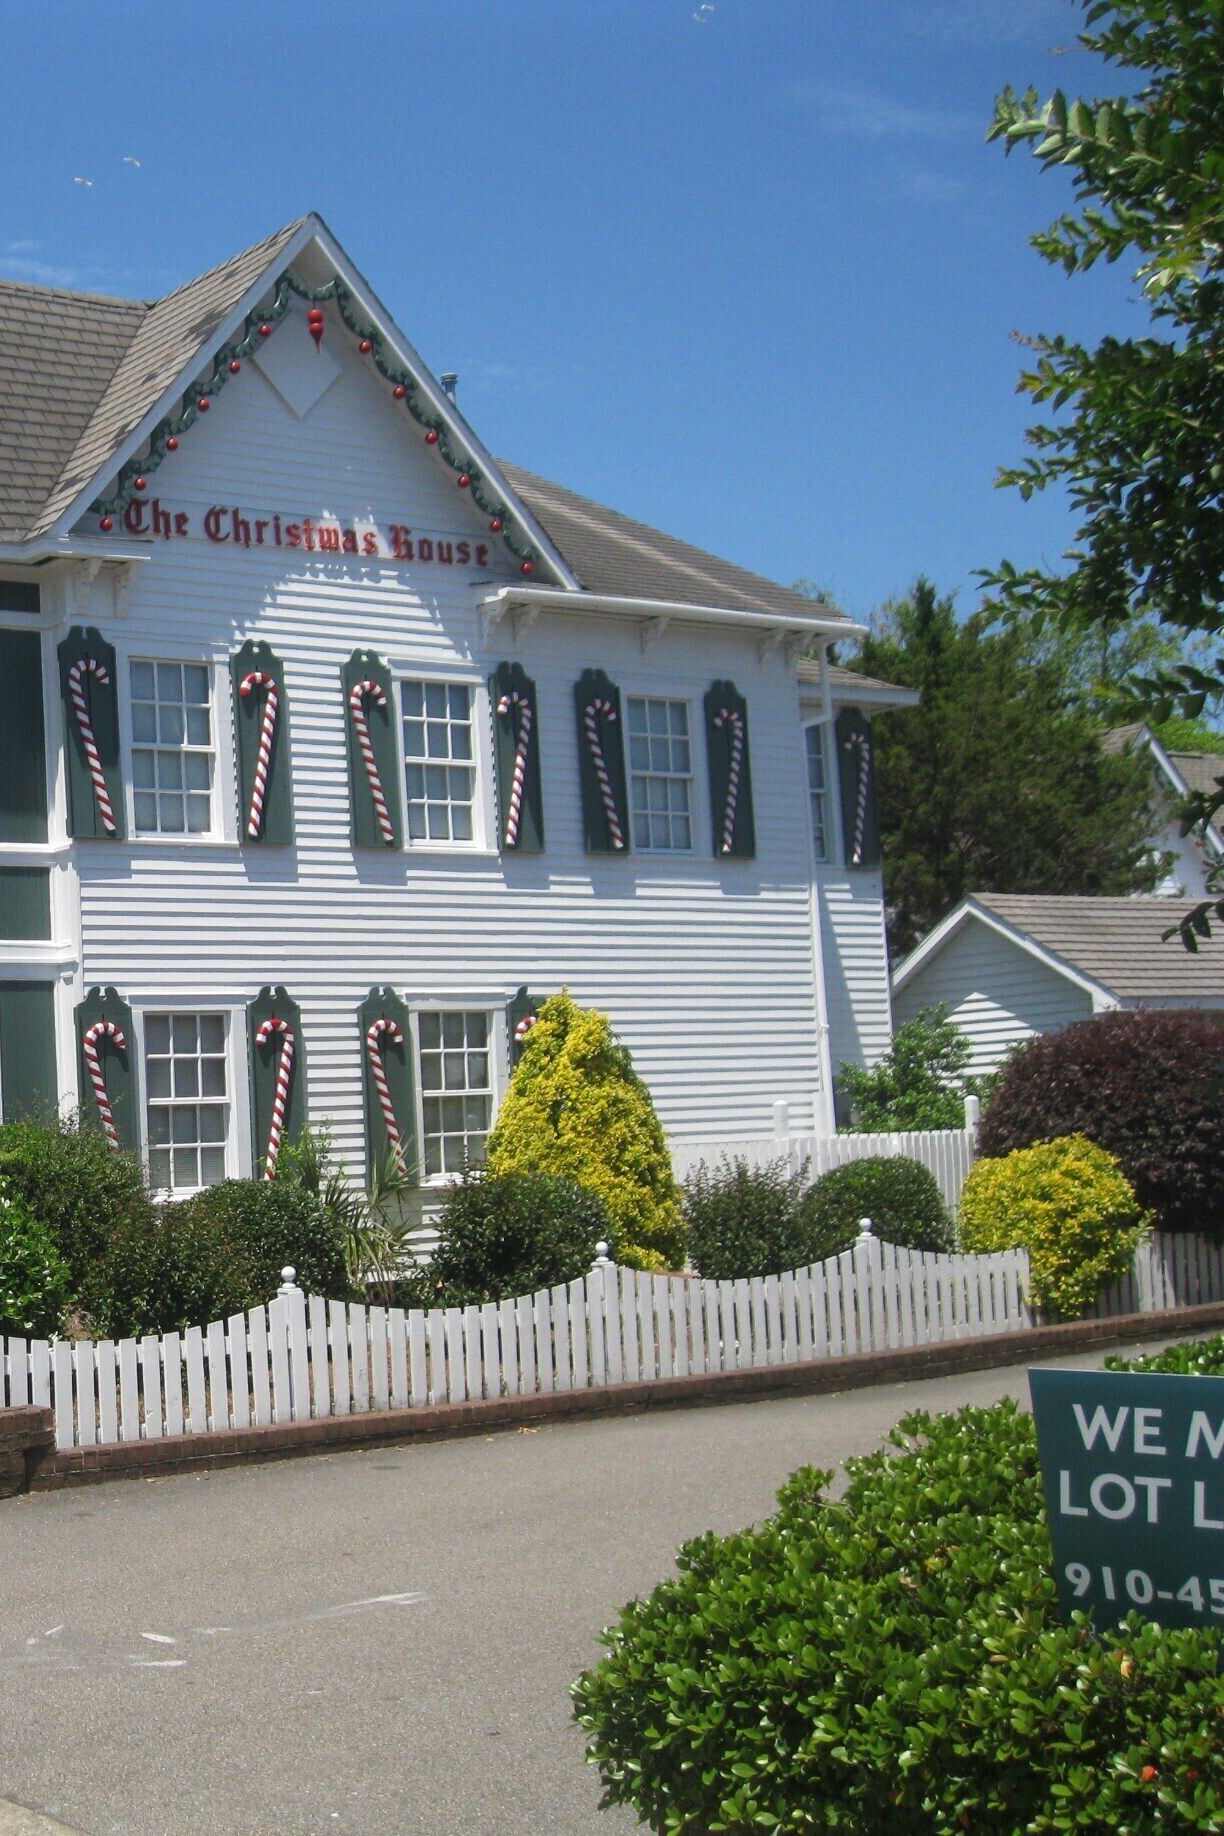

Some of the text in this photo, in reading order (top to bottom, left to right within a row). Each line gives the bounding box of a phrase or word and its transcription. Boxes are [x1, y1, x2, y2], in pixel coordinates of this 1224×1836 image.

[124, 498, 489, 568] The Christmas House
[1072, 1403, 1167, 1456] WE
[1059, 1469, 1172, 1524] LOT
[1064, 1562, 1224, 1615] 910-45
